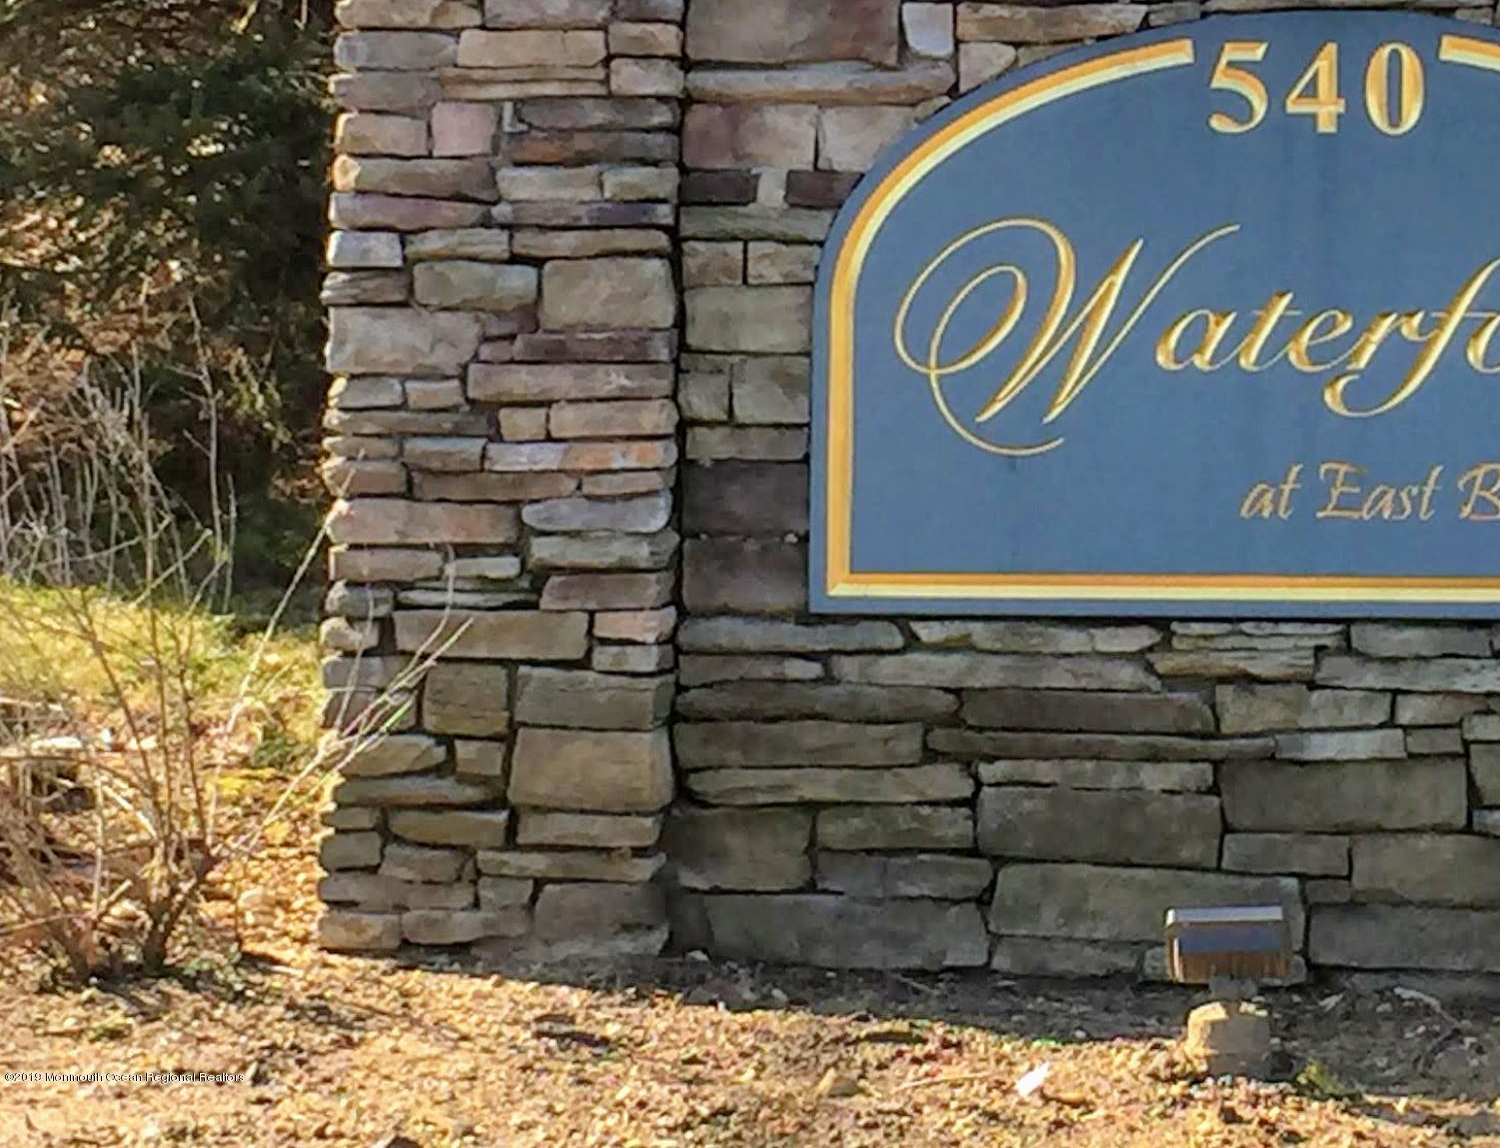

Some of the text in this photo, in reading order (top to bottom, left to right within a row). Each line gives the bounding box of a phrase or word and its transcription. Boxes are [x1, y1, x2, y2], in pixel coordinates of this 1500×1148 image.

[1207, 40, 1426, 136] 540
[1239, 463, 1304, 521] at
[1316, 463, 1442, 522] East
